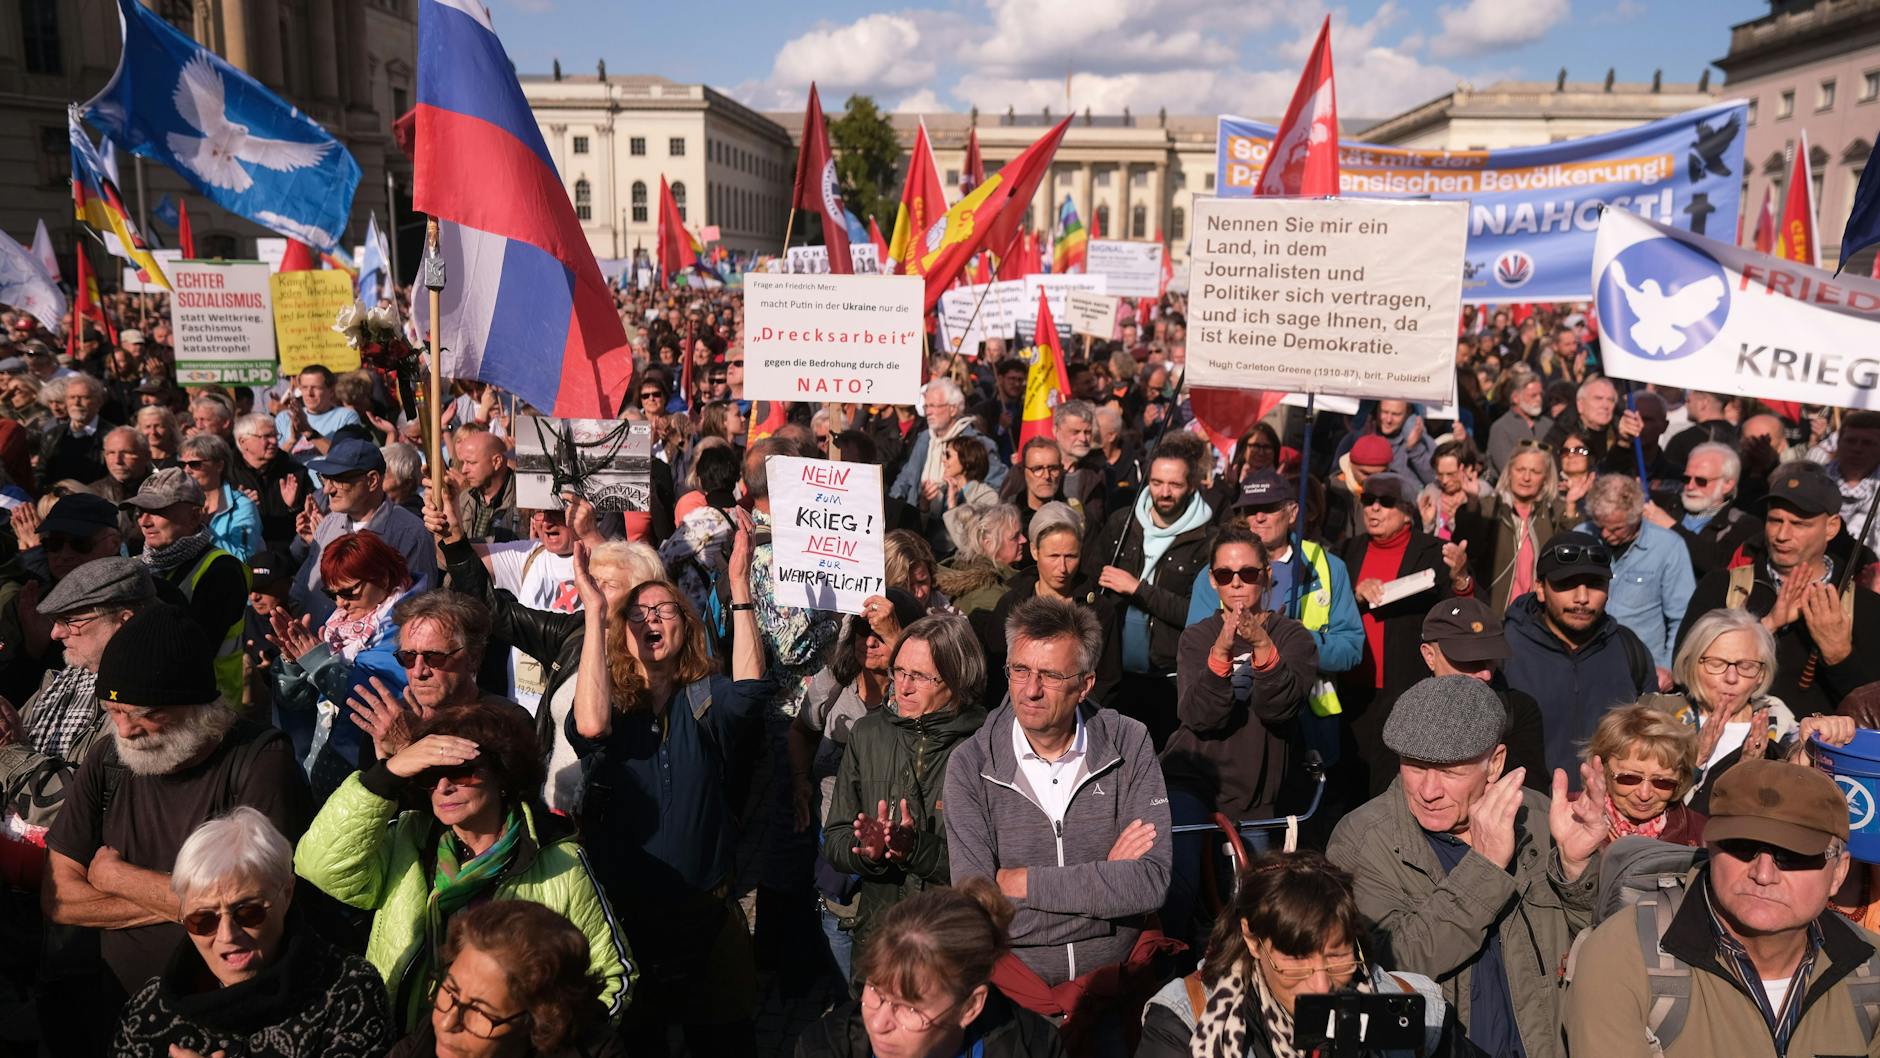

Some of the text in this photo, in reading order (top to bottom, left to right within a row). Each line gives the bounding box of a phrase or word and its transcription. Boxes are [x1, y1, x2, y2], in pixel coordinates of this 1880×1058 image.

[1479, 154, 1667, 192] Bevölkerung!
[1207, 215, 1388, 235] Nennen Sie mir ein
[1206, 238, 1327, 257] Land, in dem
[176, 271, 225, 289] ECHTER
[1204, 262, 1365, 282] Journalisten und
[753, 281, 773, 289] Frage
[785, 282, 816, 290] Friedrich
[817, 283, 838, 291] Merz:
[1739, 263, 1880, 314] FRIED
[178, 292, 266, 309] SOZIALISMUS,
[760, 300, 788, 308] macht
[790, 300, 813, 309] Putin
[815, 301, 824, 309] in
[825, 302, 842, 310] der
[843, 302, 877, 312] Ukraine
[895, 304, 909, 313] die
[1204, 284, 1432, 312] Politiker sich vertragen,
[180, 314, 205, 322] statt
[1202, 308, 1418, 333] und ich sage Ihnen, da
[181, 324, 243, 332] Faschismus
[182, 334, 251, 343] und Umwelt-
[1201, 327, 1399, 356] ist keine Demokratie.
[183, 344, 251, 354] katastrophe!
[764, 358, 900, 370] gegen die Bedrohung durch die
[1208, 360, 1431, 384] Hugh Carleton Greene (1910-87), brit. Publizist
[1734, 342, 1880, 390] KRIEG
[223, 368, 273, 382] MLPD
[796, 377, 874, 394] NATO?
[802, 465, 851, 486] NEIN
[795, 506, 858, 532] KRIEG
[807, 535, 858, 557] NEIN
[818, 559, 841, 570] ZUR
[779, 566, 872, 594] WEHRPFLICHT
